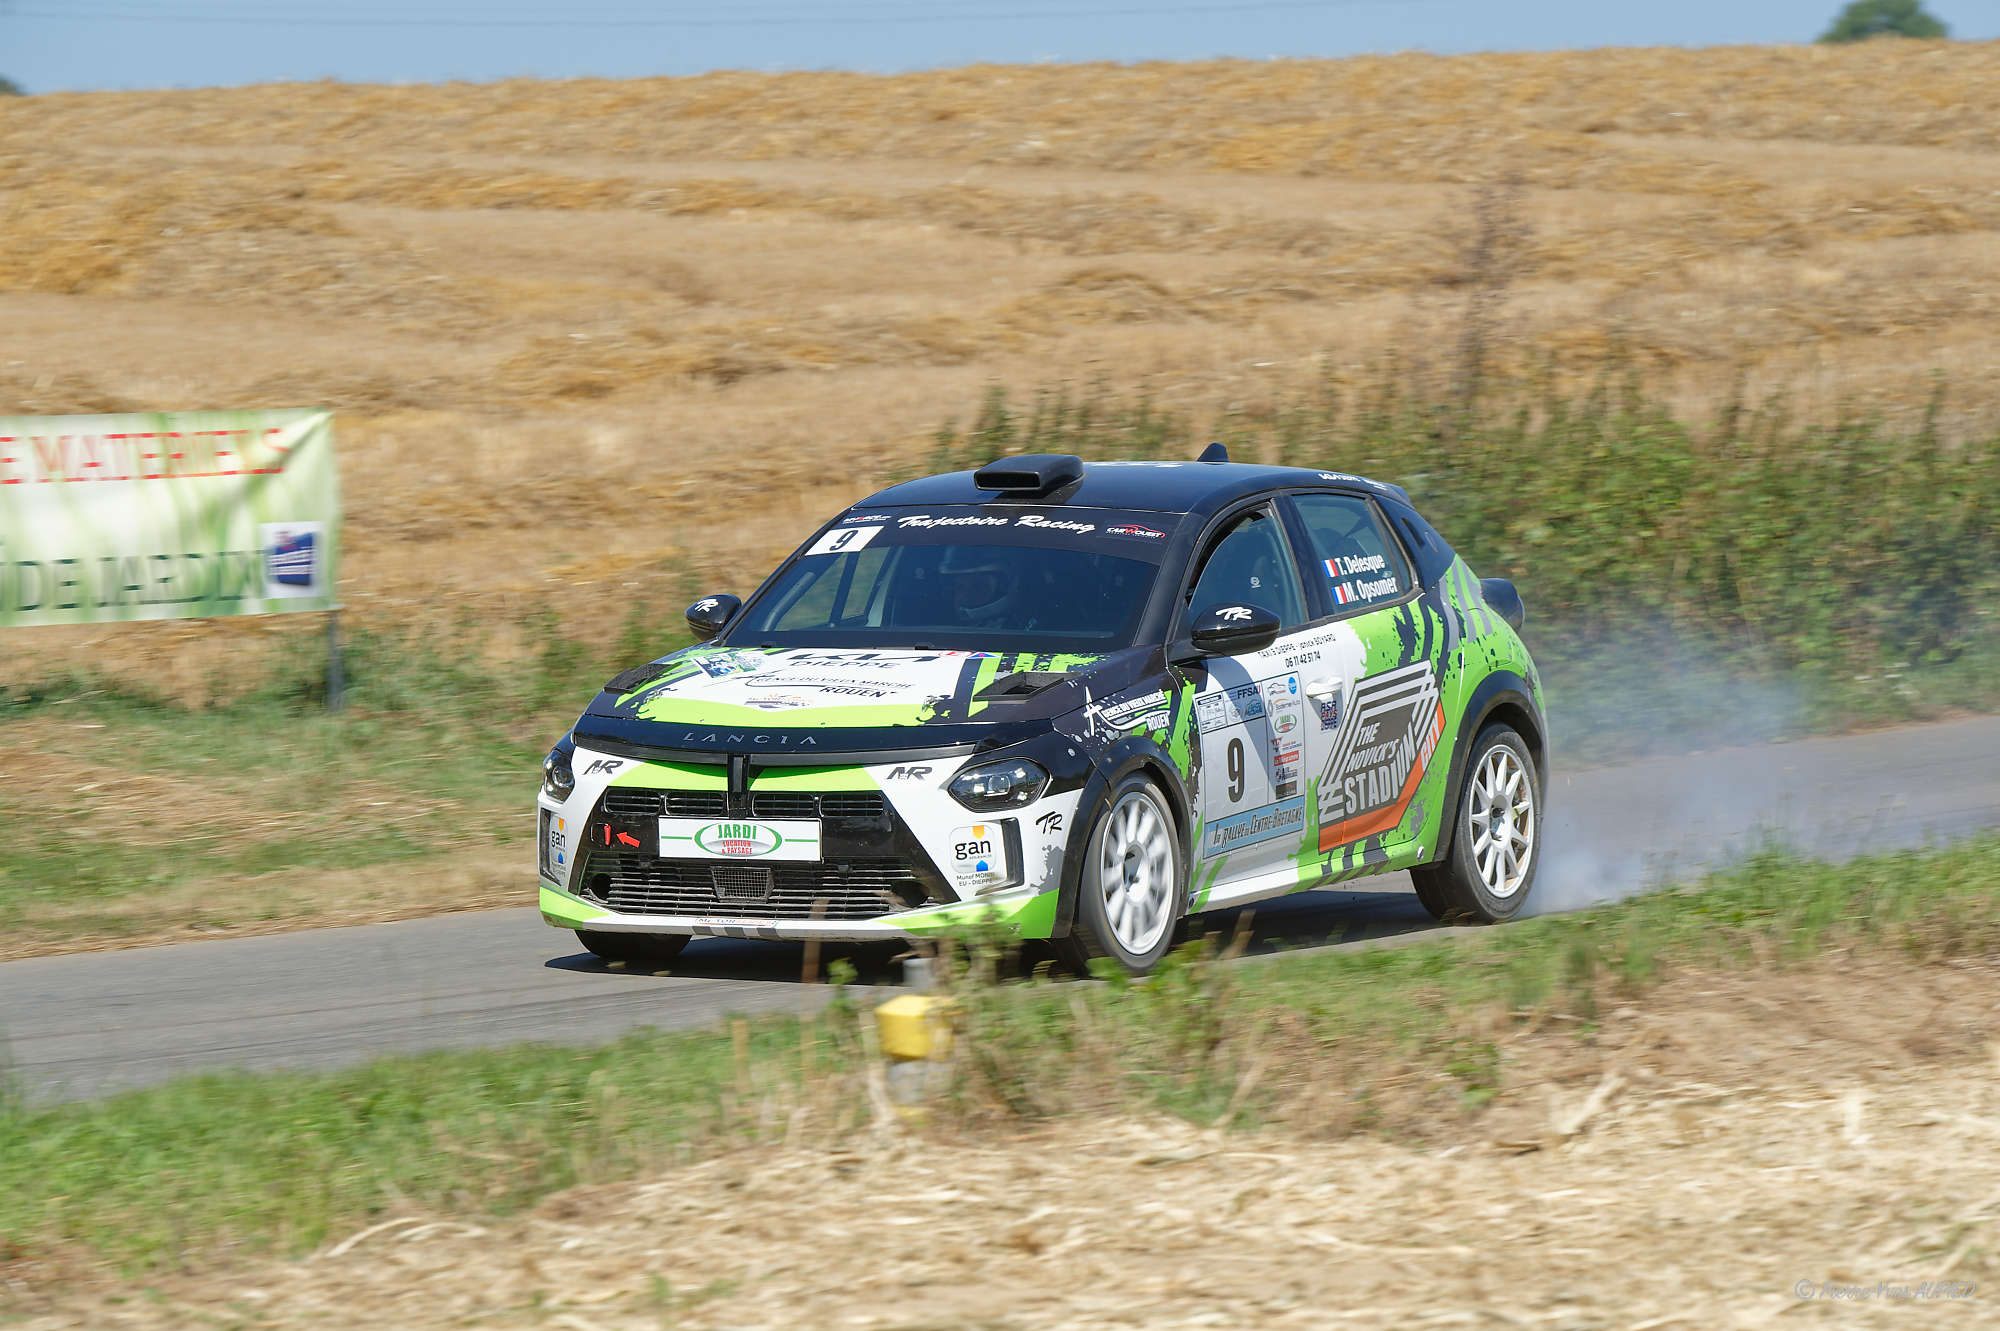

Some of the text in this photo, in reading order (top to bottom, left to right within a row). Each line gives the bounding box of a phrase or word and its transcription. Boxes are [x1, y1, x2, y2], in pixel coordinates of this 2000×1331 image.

[896, 515, 1008, 530] Trajectoire
[1013, 515, 1097, 533] Racing
[829, 529, 859, 551] 9
[1346, 553, 1386, 576] Delesque
[1345, 576, 1398, 603] M. Opsomer
[1215, 606, 1253, 621] TR
[790, 660, 901, 669] DIEPPE
[819, 686, 888, 698] ROUEN
[1237, 685, 1259, 699] FFSA
[1146, 712, 1170, 732] ROUEN
[683, 732, 817, 745] LANCIA
[1356, 721, 1381, 747] THE
[1420, 714, 1440, 773] CITY
[1227, 737, 1245, 803] 9
[1344, 721, 1418, 815] STADIUM
[717, 823, 757, 840] JARDI
[1035, 811, 1064, 835] TR
[551, 830, 566, 848] gan
[954, 840, 991, 861] gan
